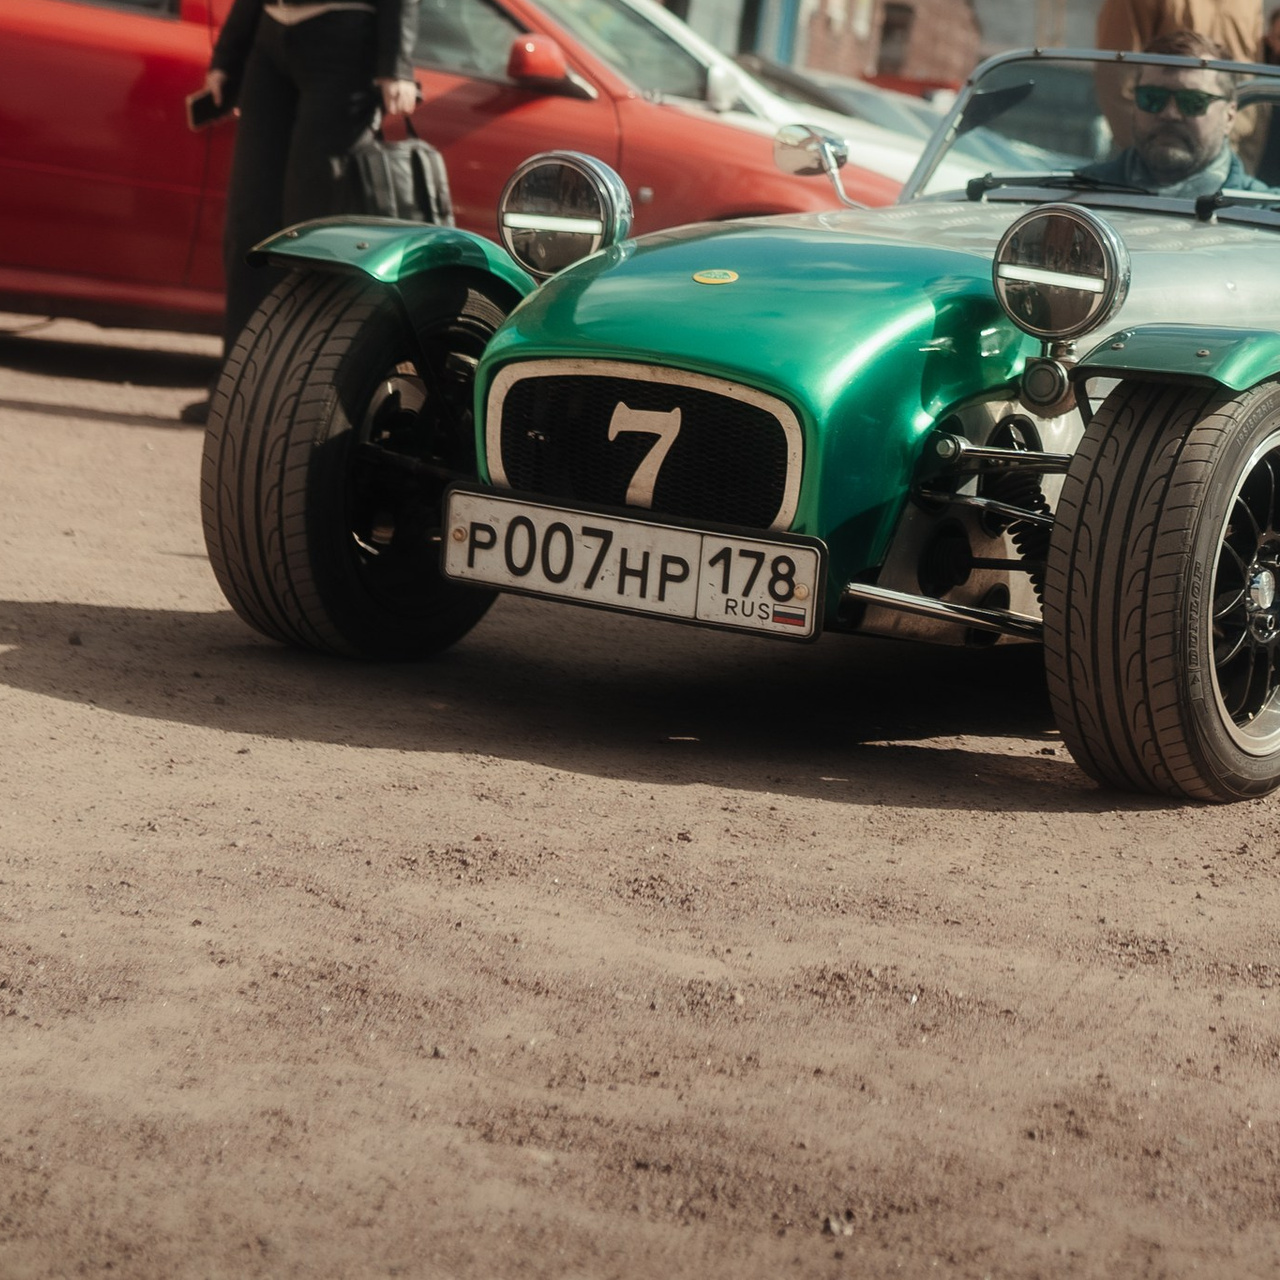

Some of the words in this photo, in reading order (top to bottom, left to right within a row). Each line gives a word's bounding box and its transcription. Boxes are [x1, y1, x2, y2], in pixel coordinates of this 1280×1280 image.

[608, 401, 682, 509] 7
[467, 515, 691, 602] P007HP
[708, 546, 797, 602] 178
[725, 598, 770, 620] RUS
[1188, 561, 1203, 667] DUNLOP
